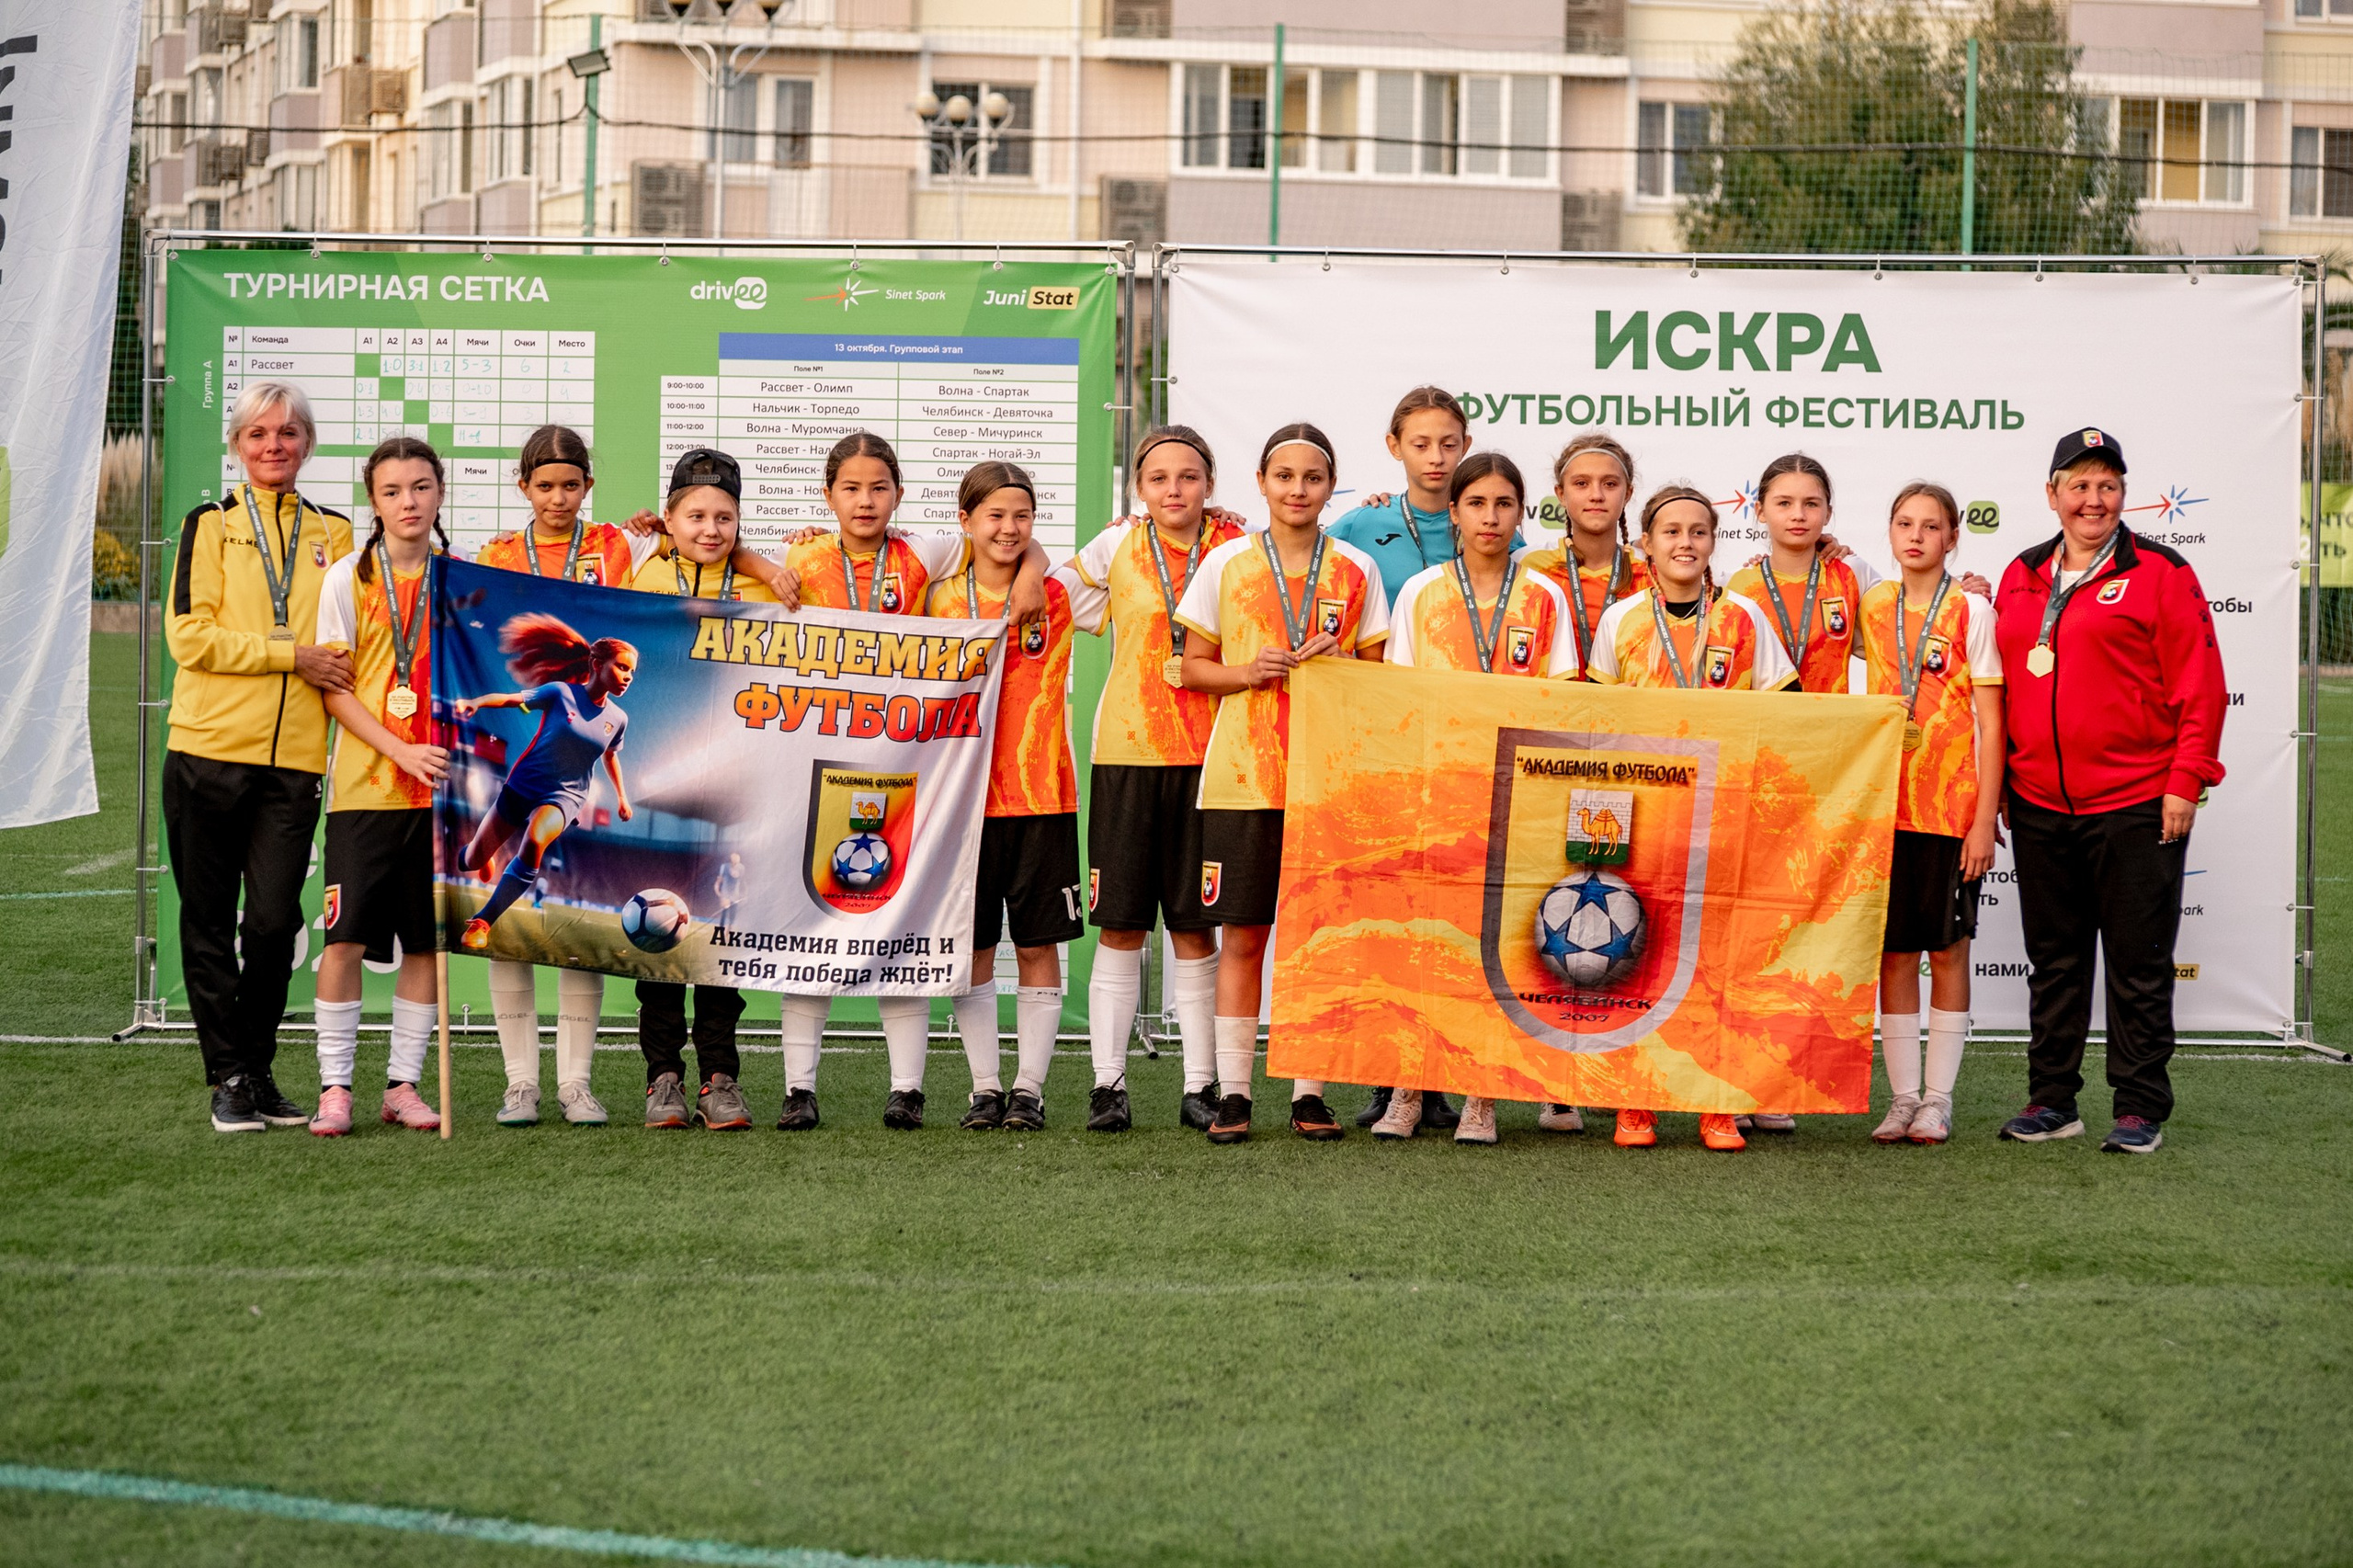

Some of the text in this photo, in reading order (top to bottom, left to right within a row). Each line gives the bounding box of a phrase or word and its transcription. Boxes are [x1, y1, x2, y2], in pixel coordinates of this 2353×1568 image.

[223, 273, 550, 302] ТУРНИРНАЯ СЕТКА
[690, 278, 767, 306] drivee
[885, 290, 946, 301] Sinet Spark
[252, 335, 289, 345] Команда
[466, 338, 489, 347] Мячи
[514, 339, 536, 347] Очки
[558, 339, 585, 347] Место
[1595, 310, 1882, 373] ИСКРА
[835, 344, 963, 355] 13 октября. Групповой этап
[251, 359, 294, 369] Рассвет
[202, 374, 213, 409] Группа
[760, 382, 854, 393] Рассвет Олимп
[938, 385, 1029, 399] Волна Спартак
[753, 403, 860, 416] Нальчик Торпедо
[922, 404, 1053, 419] Челябинск Девяточка
[1456, 387, 2025, 430] ФУТБОЛЬНЫЙ ФЕСТИВАЛЬ
[666, 423, 704, 431] 11:00-12:00
[746, 423, 865, 437] Волна Муромчанка
[933, 426, 1043, 441] Север Мичуринск
[756, 444, 801, 455] Рассвет
[933, 448, 1041, 460] Спартак Ногай-Эл
[465, 467, 487, 475] Мячи
[758, 485, 794, 495] Волна
[756, 506, 800, 517] Рассвет
[1717, 528, 1768, 542] inet Spa
[2170, 532, 2206, 547] Spark
[689, 615, 999, 682] АКАДЕМИЯ
[733, 682, 983, 743] ФУТБОЛА
[2182, 903, 2204, 916] ark
[710, 926, 954, 960] Академия вперёд и
[718, 958, 953, 986] тебя победа ждёт!
[1975, 962, 2029, 977] нами
[2175, 967, 2196, 978] tat
[1518, 992, 1654, 1010] ЧЕЛЯБИНСК
[1559, 1012, 1610, 1022] 2007
